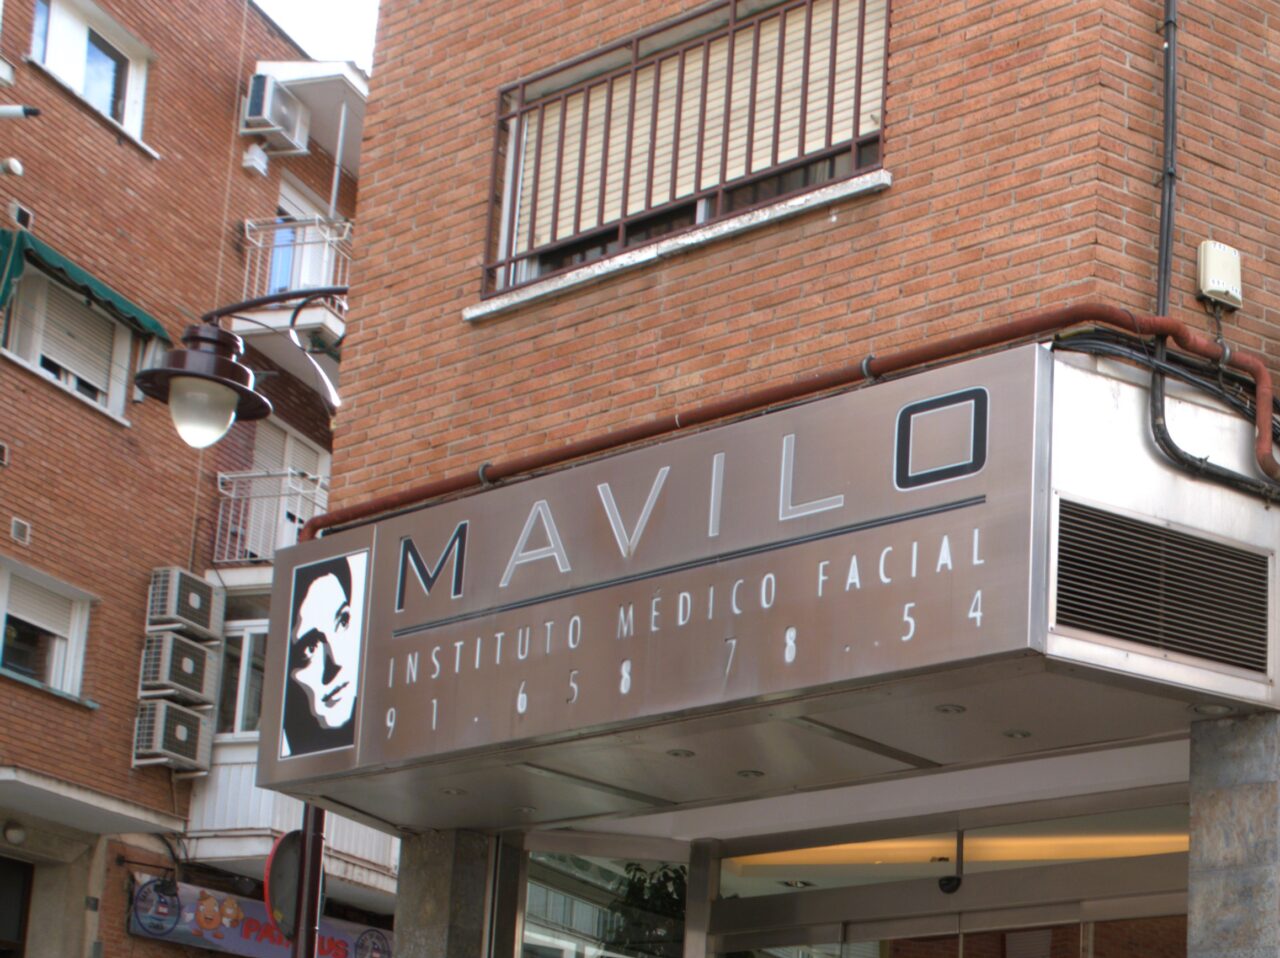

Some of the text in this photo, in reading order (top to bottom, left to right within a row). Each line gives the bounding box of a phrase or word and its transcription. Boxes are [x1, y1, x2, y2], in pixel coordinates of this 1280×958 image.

[394, 386, 990, 613] MAVILO
[387, 615, 582, 689] INSTITUTO
[817, 528, 985, 598] FACIAL
